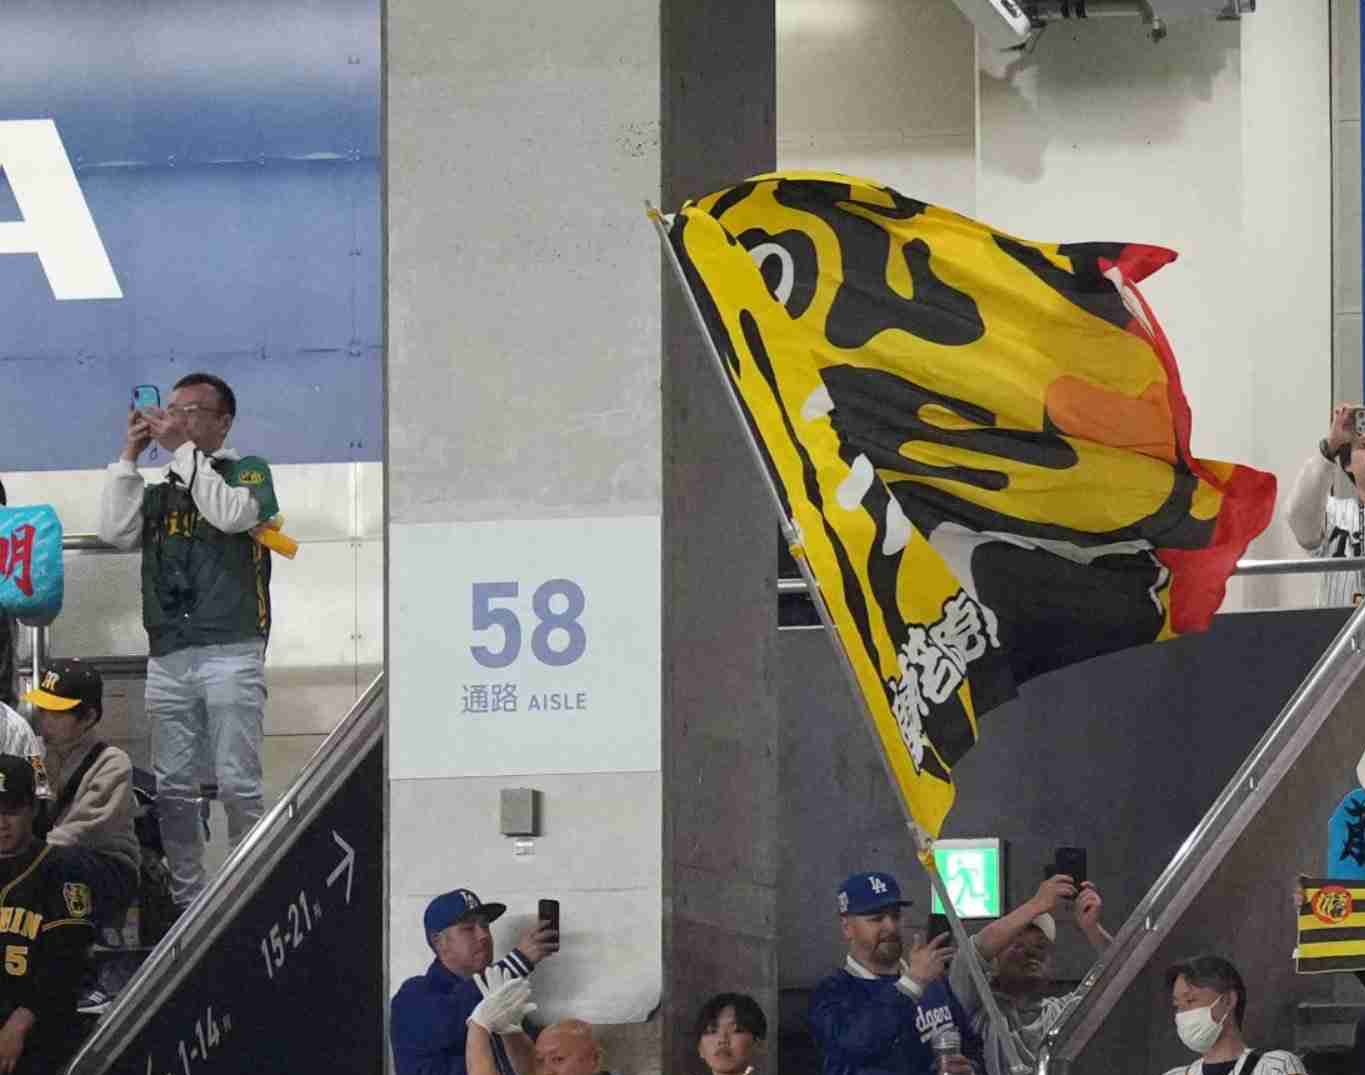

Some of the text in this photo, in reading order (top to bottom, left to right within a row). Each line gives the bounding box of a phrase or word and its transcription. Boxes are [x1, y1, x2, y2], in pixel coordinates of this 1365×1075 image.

[469, 578, 588, 669] 58
[461, 685, 587, 714] 通路 AISLE
[5, 945, 29, 976] 5
